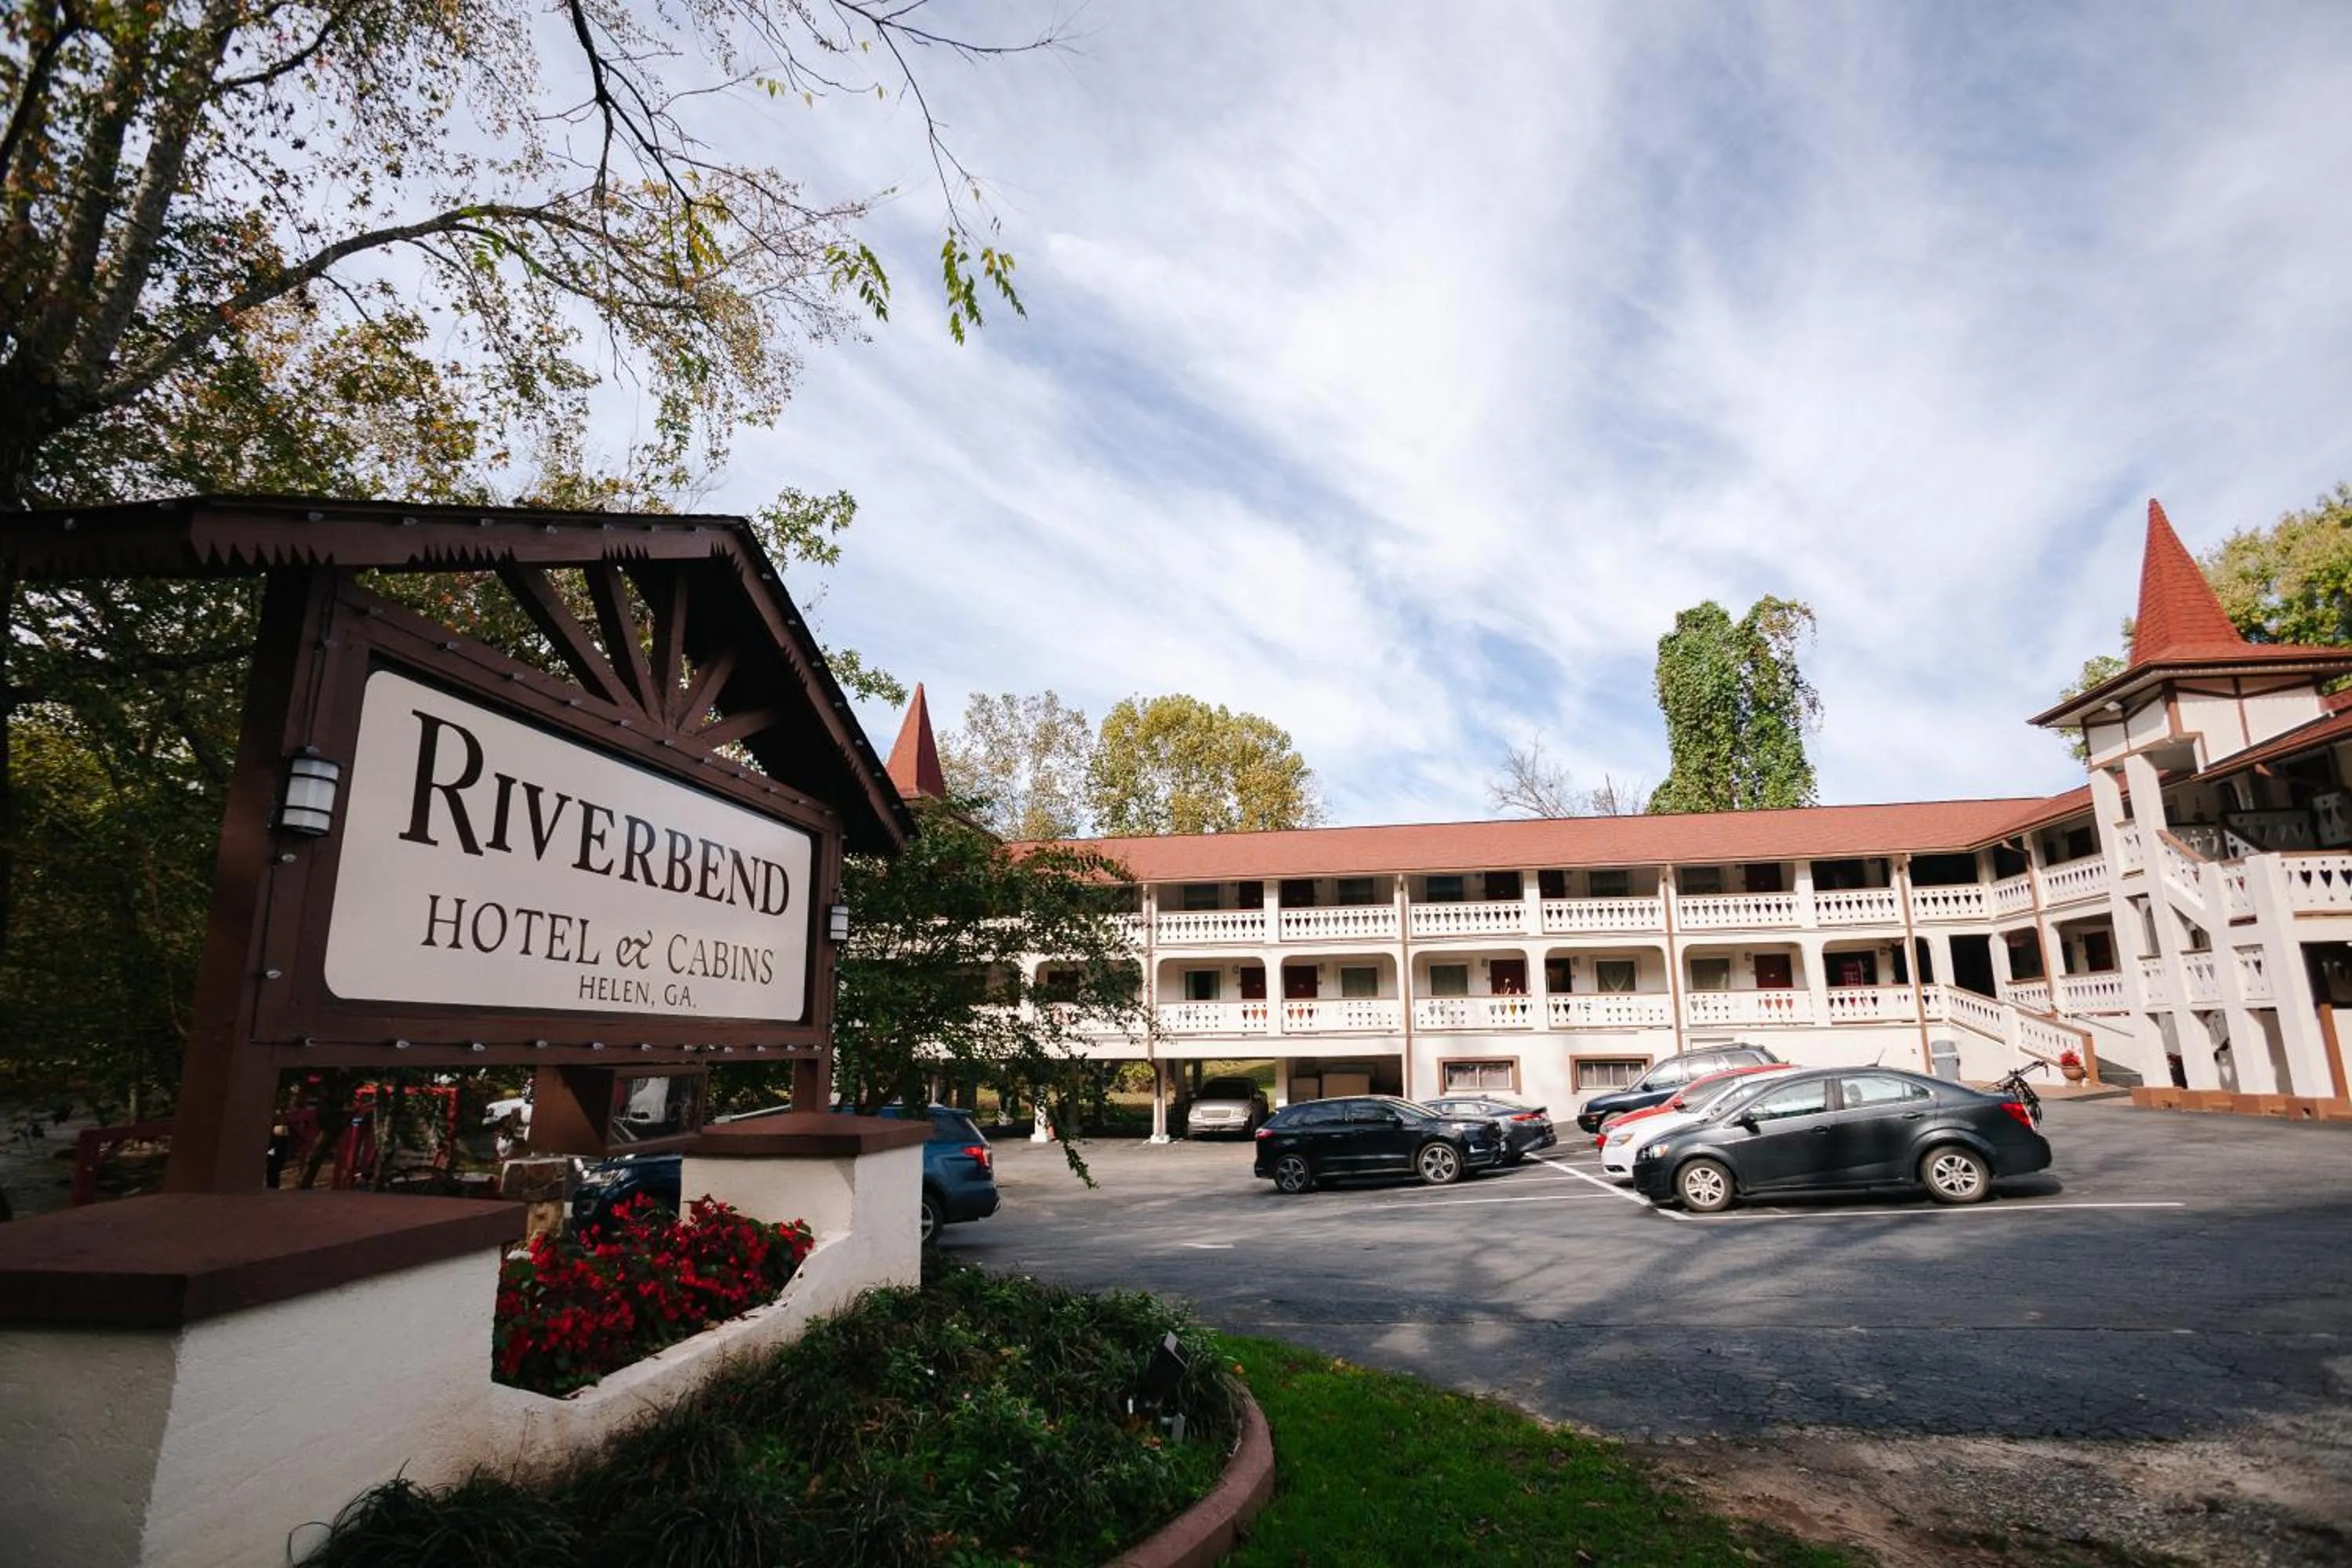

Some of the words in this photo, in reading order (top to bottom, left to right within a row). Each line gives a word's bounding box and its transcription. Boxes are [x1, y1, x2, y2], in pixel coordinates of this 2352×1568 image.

[398, 709, 789, 916] RIVERBEND
[421, 895, 601, 965] HOTEL
[615, 930, 652, 970] &
[667, 934, 774, 985] CABINS
[579, 975, 655, 1007] HELEN,
[664, 984, 697, 1009] GA.
